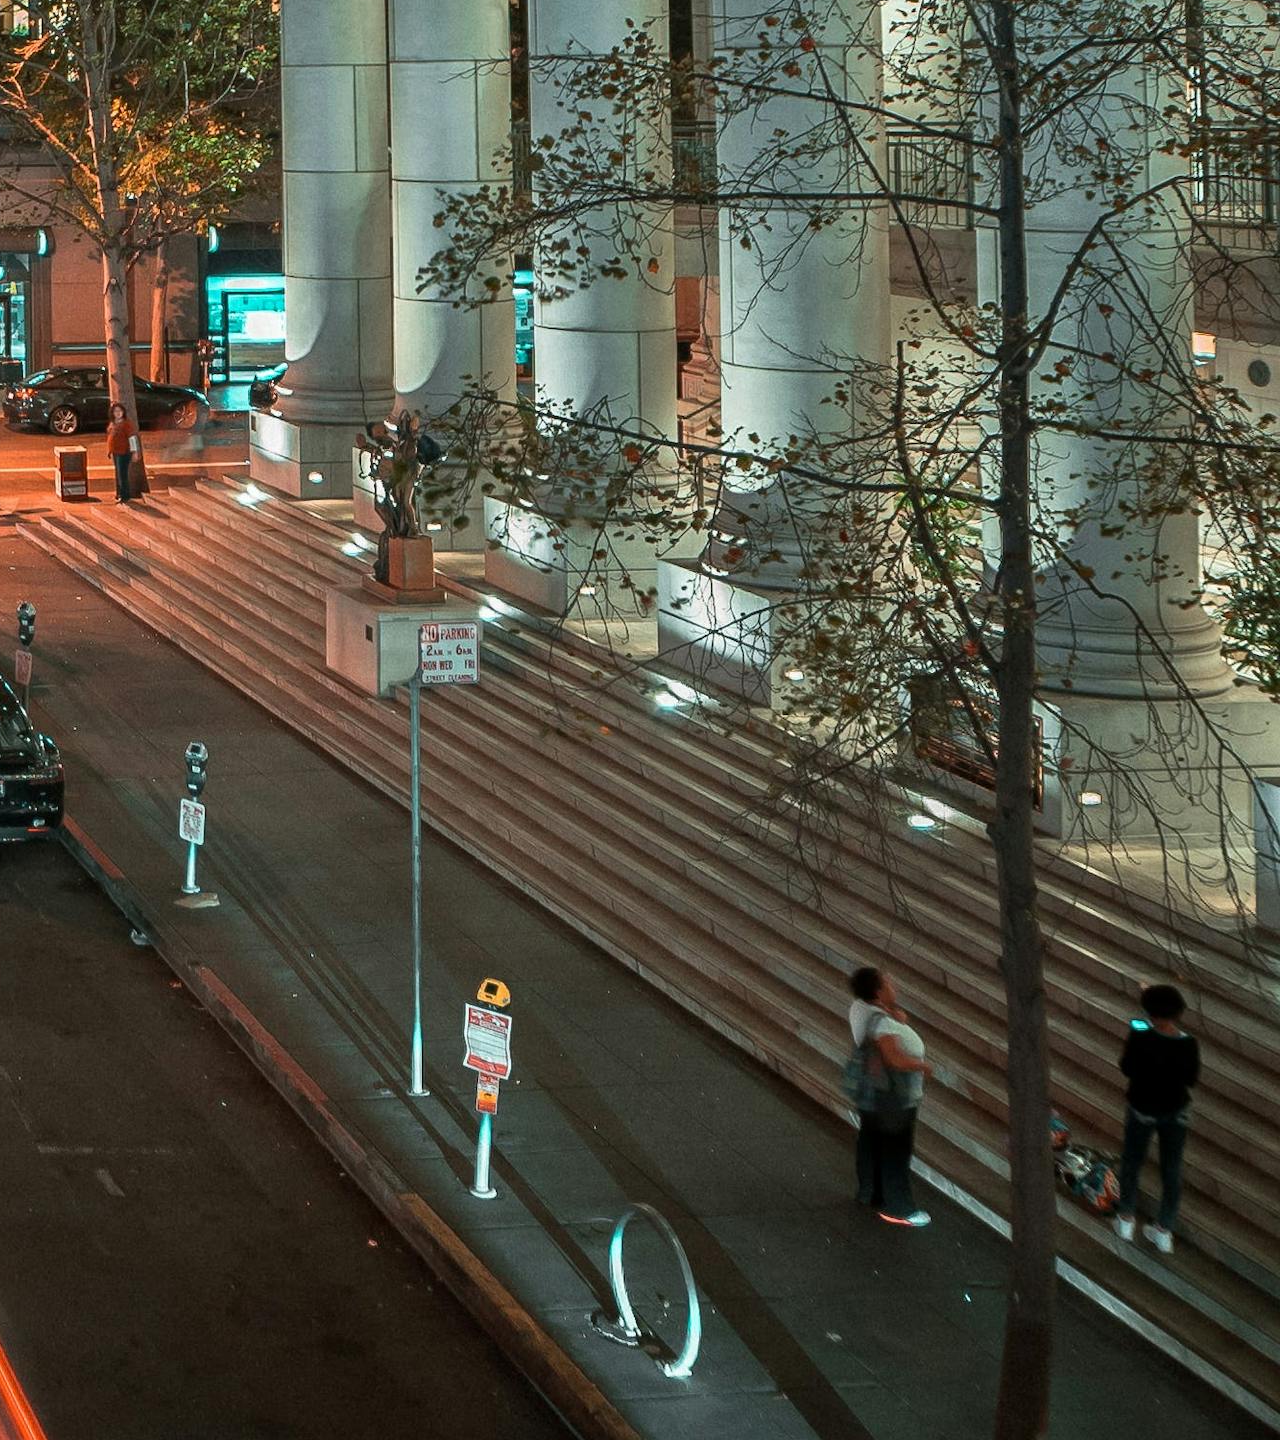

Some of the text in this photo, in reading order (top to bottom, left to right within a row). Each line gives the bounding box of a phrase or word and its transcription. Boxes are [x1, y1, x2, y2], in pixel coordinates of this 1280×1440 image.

[422, 625, 475, 641] NO PARKING
[422, 660, 475, 670] MON WED FRI
